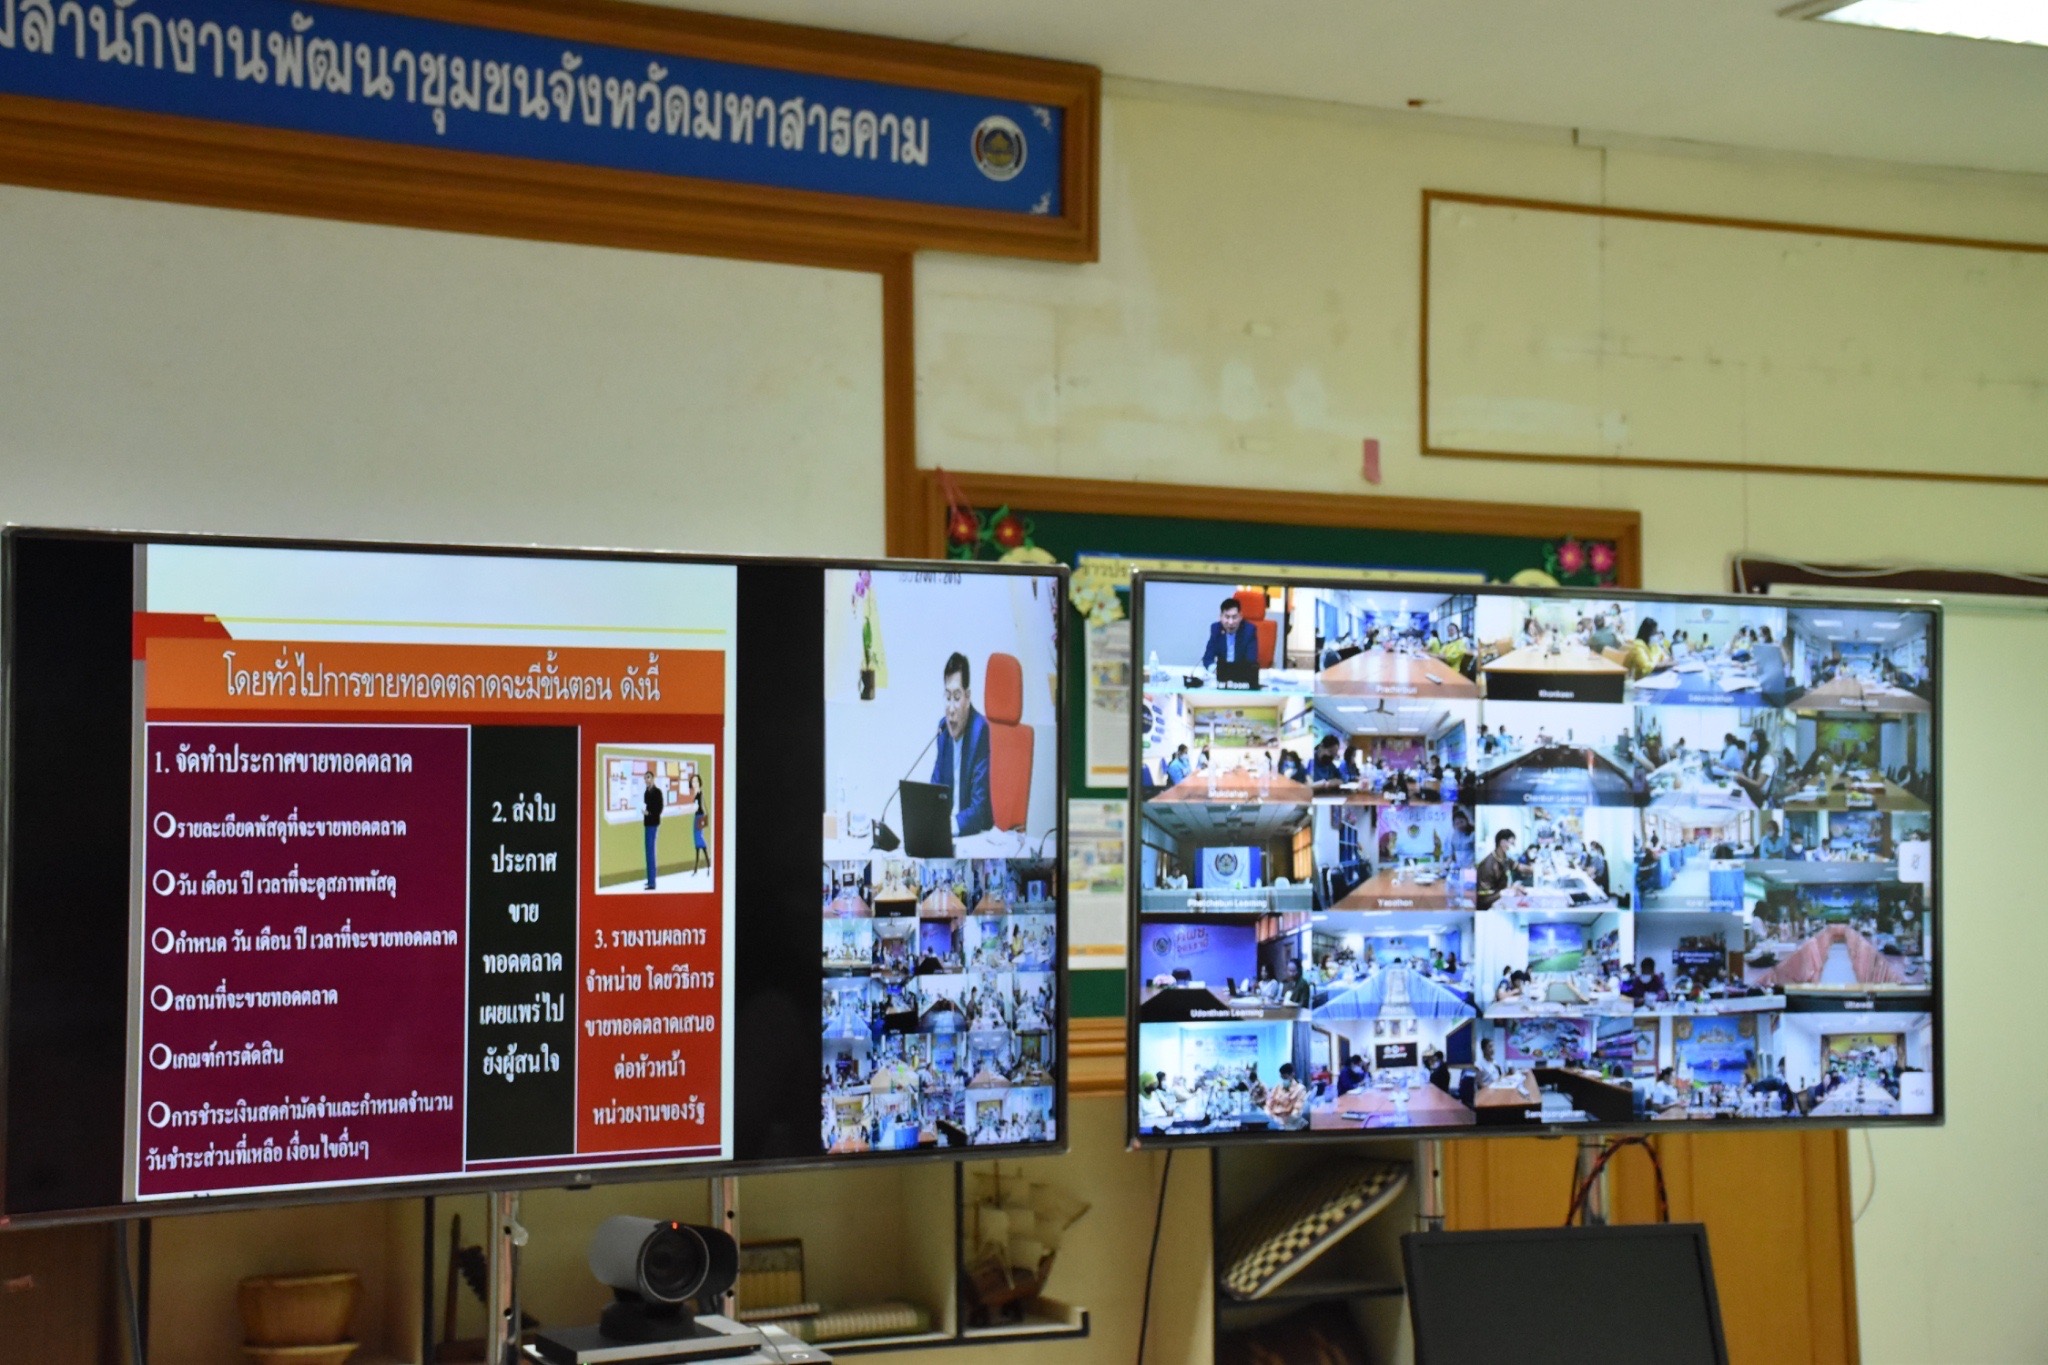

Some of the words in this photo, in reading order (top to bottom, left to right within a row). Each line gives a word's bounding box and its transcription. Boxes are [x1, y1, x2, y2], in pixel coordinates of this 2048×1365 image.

[619, 653, 662, 702] ดังนี้
[155, 751, 170, 774] 1.
[175, 742, 413, 773] จัดทำประกาศขายทอดตลาด
[492, 801, 507, 823] 2.
[512, 792, 556, 823] ส่งใบ
[491, 844, 558, 873] ประกาศ
[176, 872, 198, 896] วัน
[201, 869, 238, 896] เดือน
[239, 869, 254, 895] ปี
[256, 862, 397, 901] เวลาที่จะดูสภาพพัสดุ
[508, 903, 540, 923] ขาย
[175, 929, 227, 954] กำหนด
[231, 928, 252, 952] วัน
[255, 925, 292, 952] เดือน
[293, 925, 308, 950] ปี
[310, 917, 458, 950] เวลาที่จะขายทอดตลาด
[594, 928, 608, 949] 3.
[611, 927, 707, 948] รายงานผลการ
[482, 952, 563, 974] ทอดตลาด
[585, 965, 642, 993] จำหน่าย
[645, 963, 715, 991] โดยวิธีการ
[174, 977, 339, 1012] สถานที่จะขายทอดตลาด
[479, 991, 565, 1025] เผยแพร่ไป
[584, 1014, 715, 1038] ขายทอดตลาดเสนอ
[172, 1040, 284, 1070] เกณฑ์การตัดสิน
[482, 1042, 560, 1083] ยังผู้สนใจ
[613, 1049, 686, 1080] ต่อหัวหน้า
[592, 1094, 706, 1126] หน่วยงานของรัฐ
